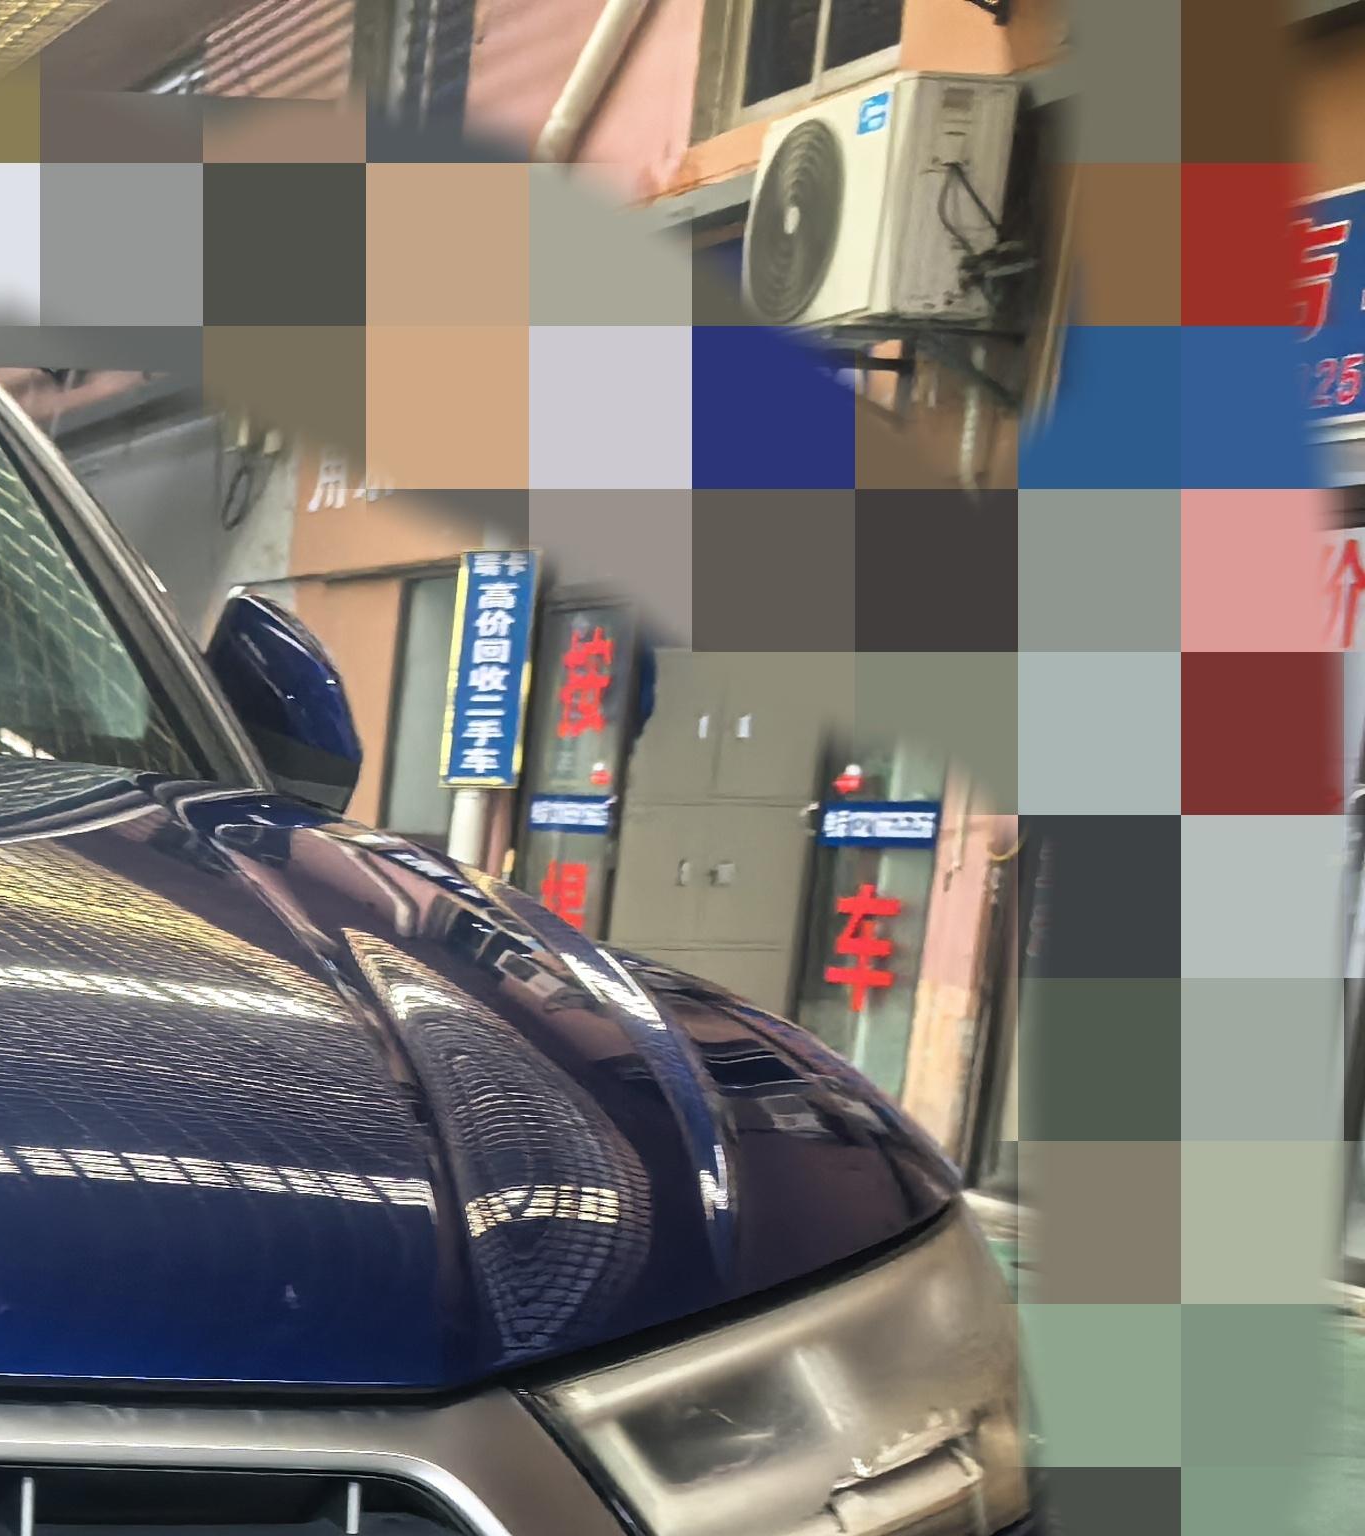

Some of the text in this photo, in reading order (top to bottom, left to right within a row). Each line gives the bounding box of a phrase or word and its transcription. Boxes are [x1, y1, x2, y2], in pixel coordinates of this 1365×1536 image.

[461, 580, 518, 775] 高价回收二手车
